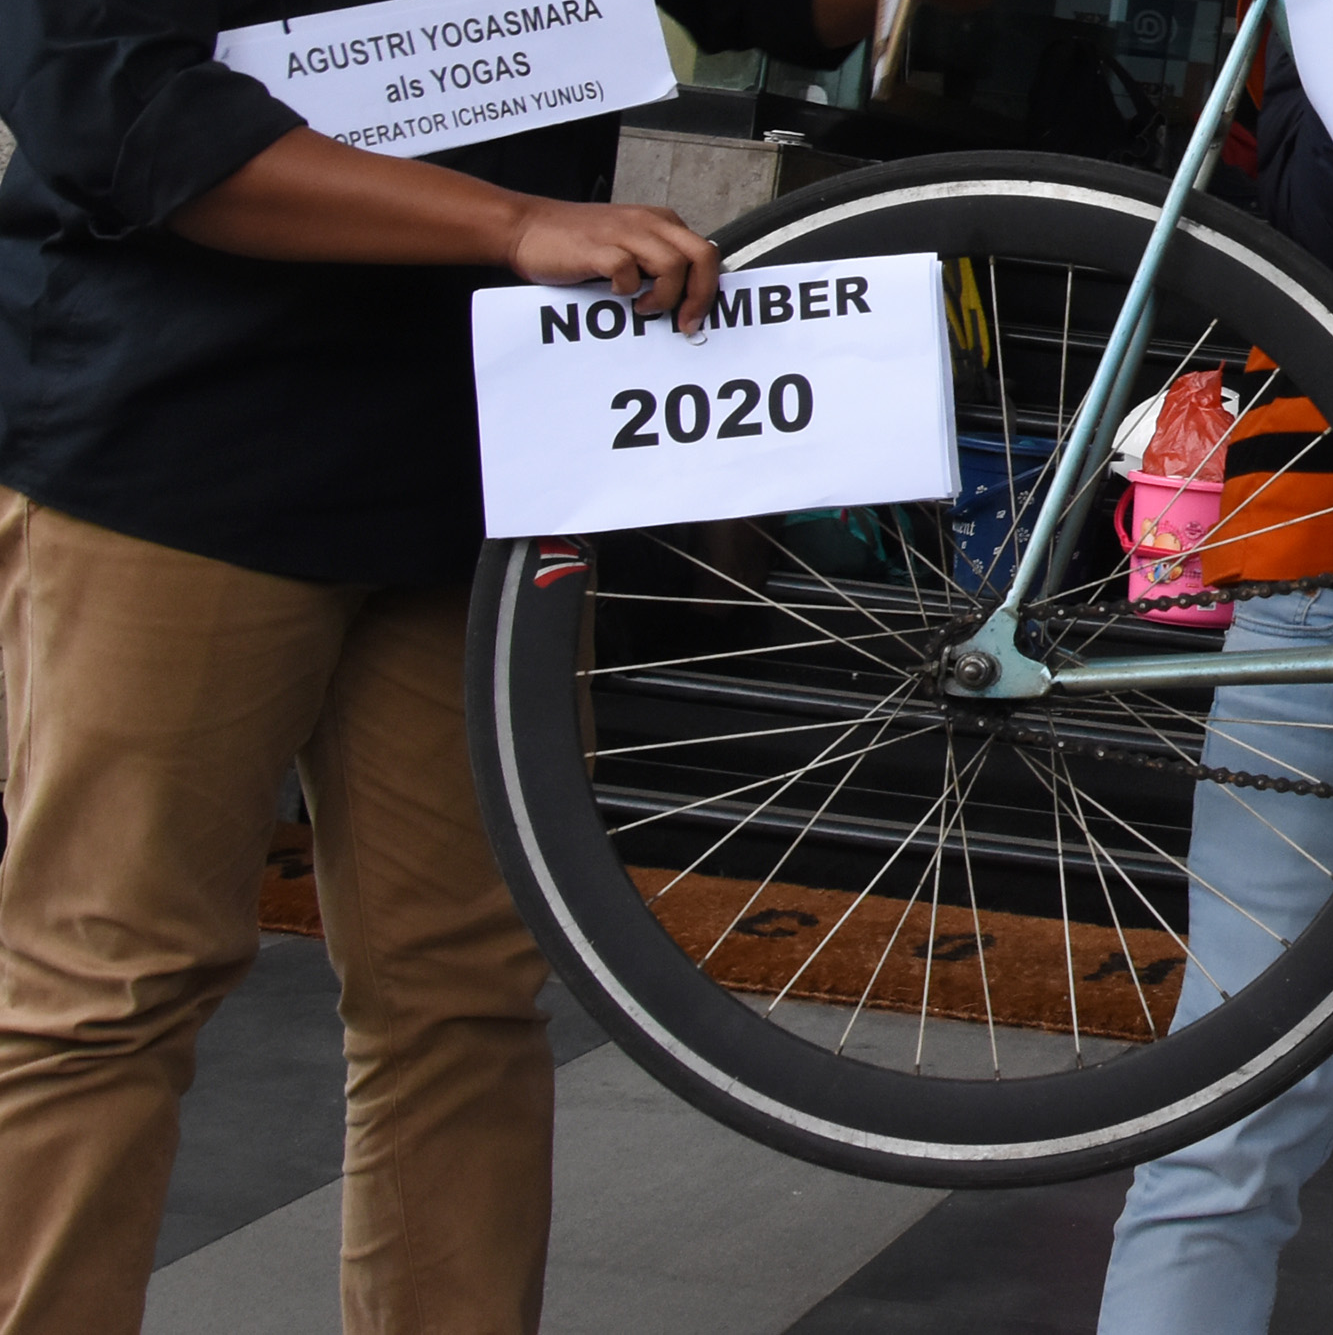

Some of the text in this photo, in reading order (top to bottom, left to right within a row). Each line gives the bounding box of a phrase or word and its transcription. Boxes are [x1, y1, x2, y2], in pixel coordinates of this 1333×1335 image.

[286, 31, 416, 79] AGUSTRI
[386, 52, 532, 104] als YOGAS
[452, 98, 527, 129] ICHSAN
[530, 80, 605, 110] YUNUS)
[610, 372, 814, 450] 2020
